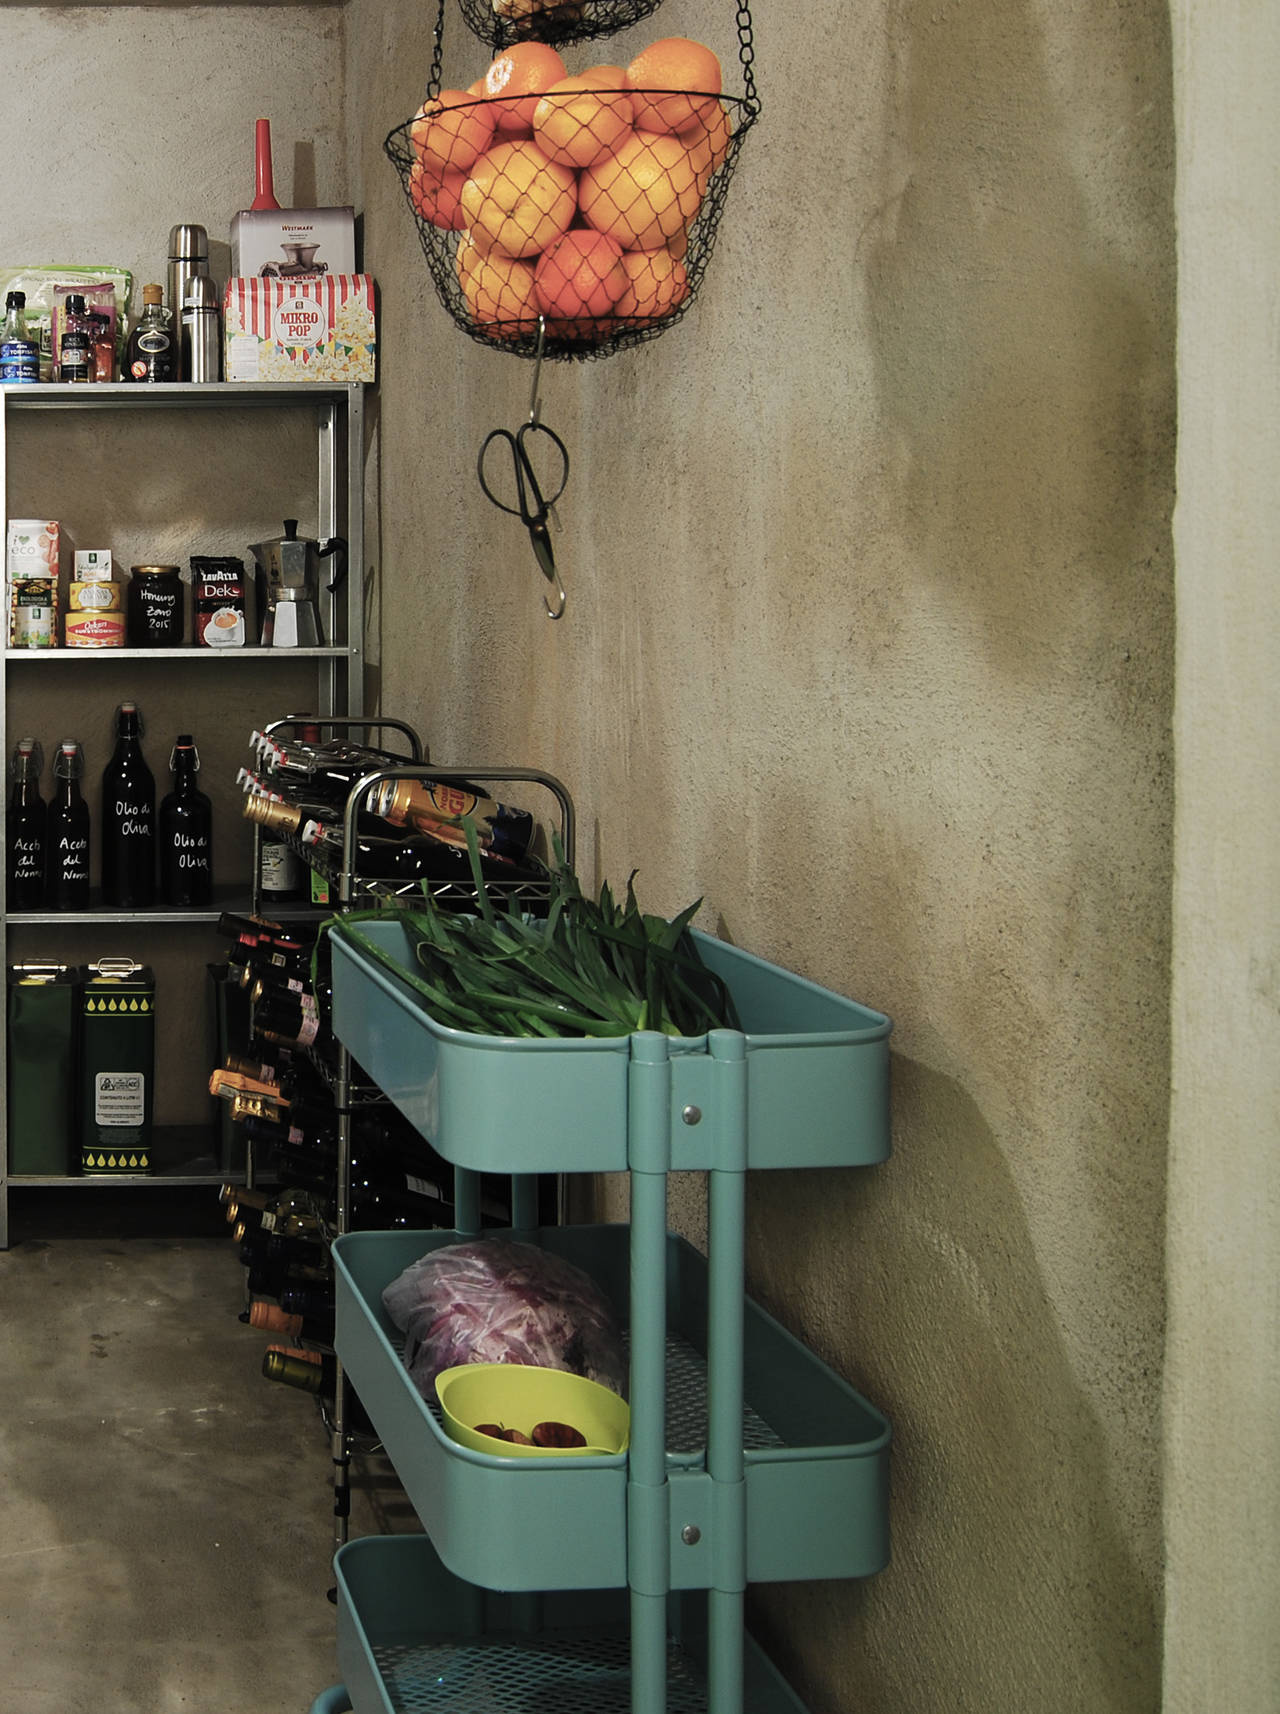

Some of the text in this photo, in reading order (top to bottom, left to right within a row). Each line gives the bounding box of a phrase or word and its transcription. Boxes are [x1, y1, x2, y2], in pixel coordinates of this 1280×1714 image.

[281, 312, 318, 324] MIKRO
[288, 325, 311, 337] POP
[12, 547, 35, 555] eco
[204, 584, 238, 597] Dek
[148, 619, 170, 629] 2015
[116, 801, 138, 815] Olio
[122, 821, 151, 836] Oliva
[174, 832, 195, 847] Olio
[179, 854, 209, 871] Oliva
